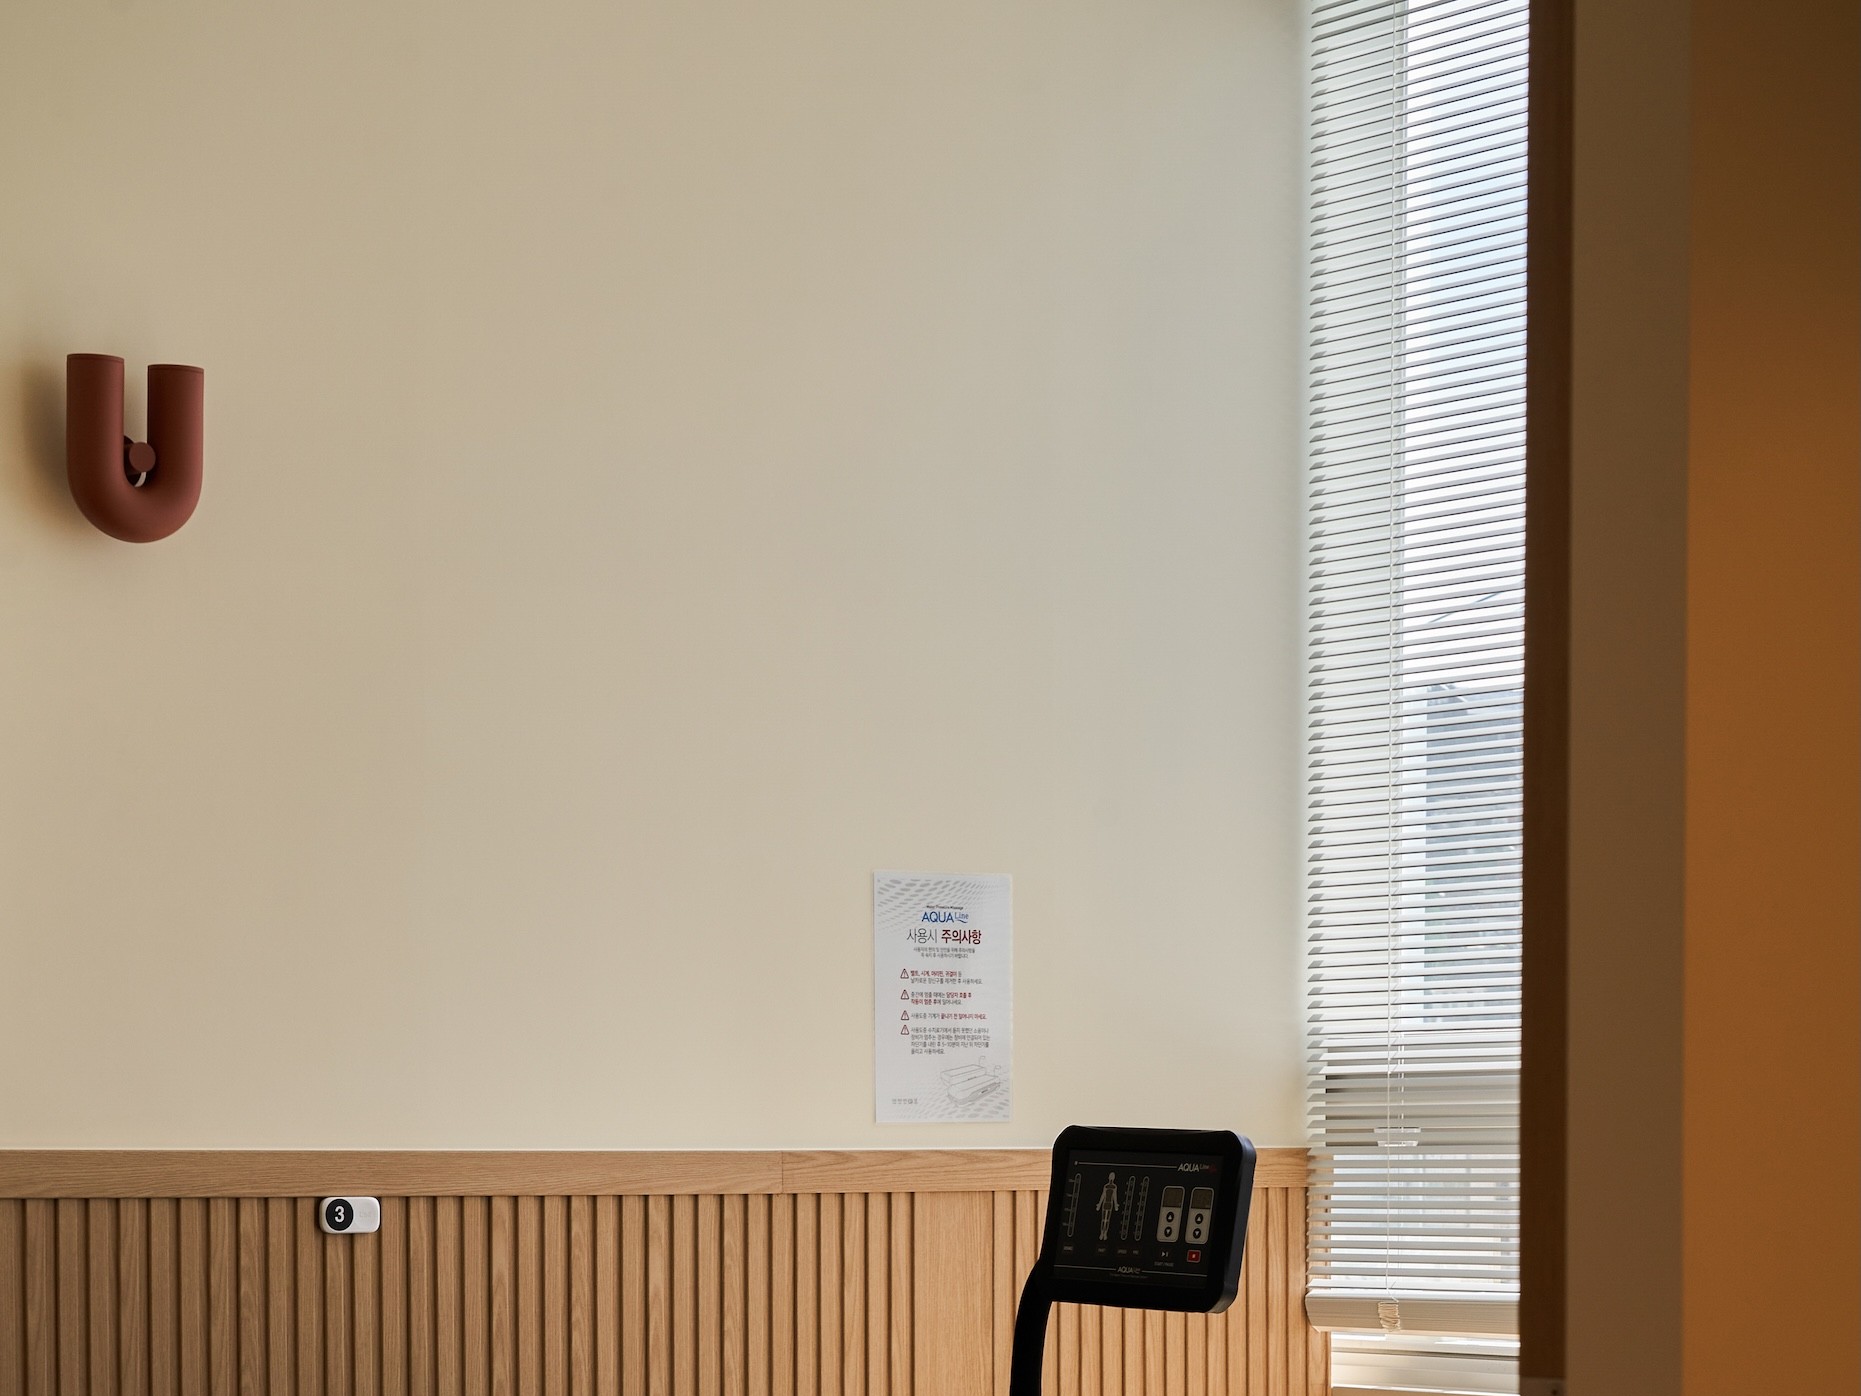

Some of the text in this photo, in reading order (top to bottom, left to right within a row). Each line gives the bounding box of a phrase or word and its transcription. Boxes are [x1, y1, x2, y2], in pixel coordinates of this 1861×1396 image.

[922, 911, 969, 923] AQUA Line
[906, 928, 982, 945] 사용시 주의사항
[1177, 1163, 1200, 1172] AQUA
[334, 1205, 345, 1223] 3
